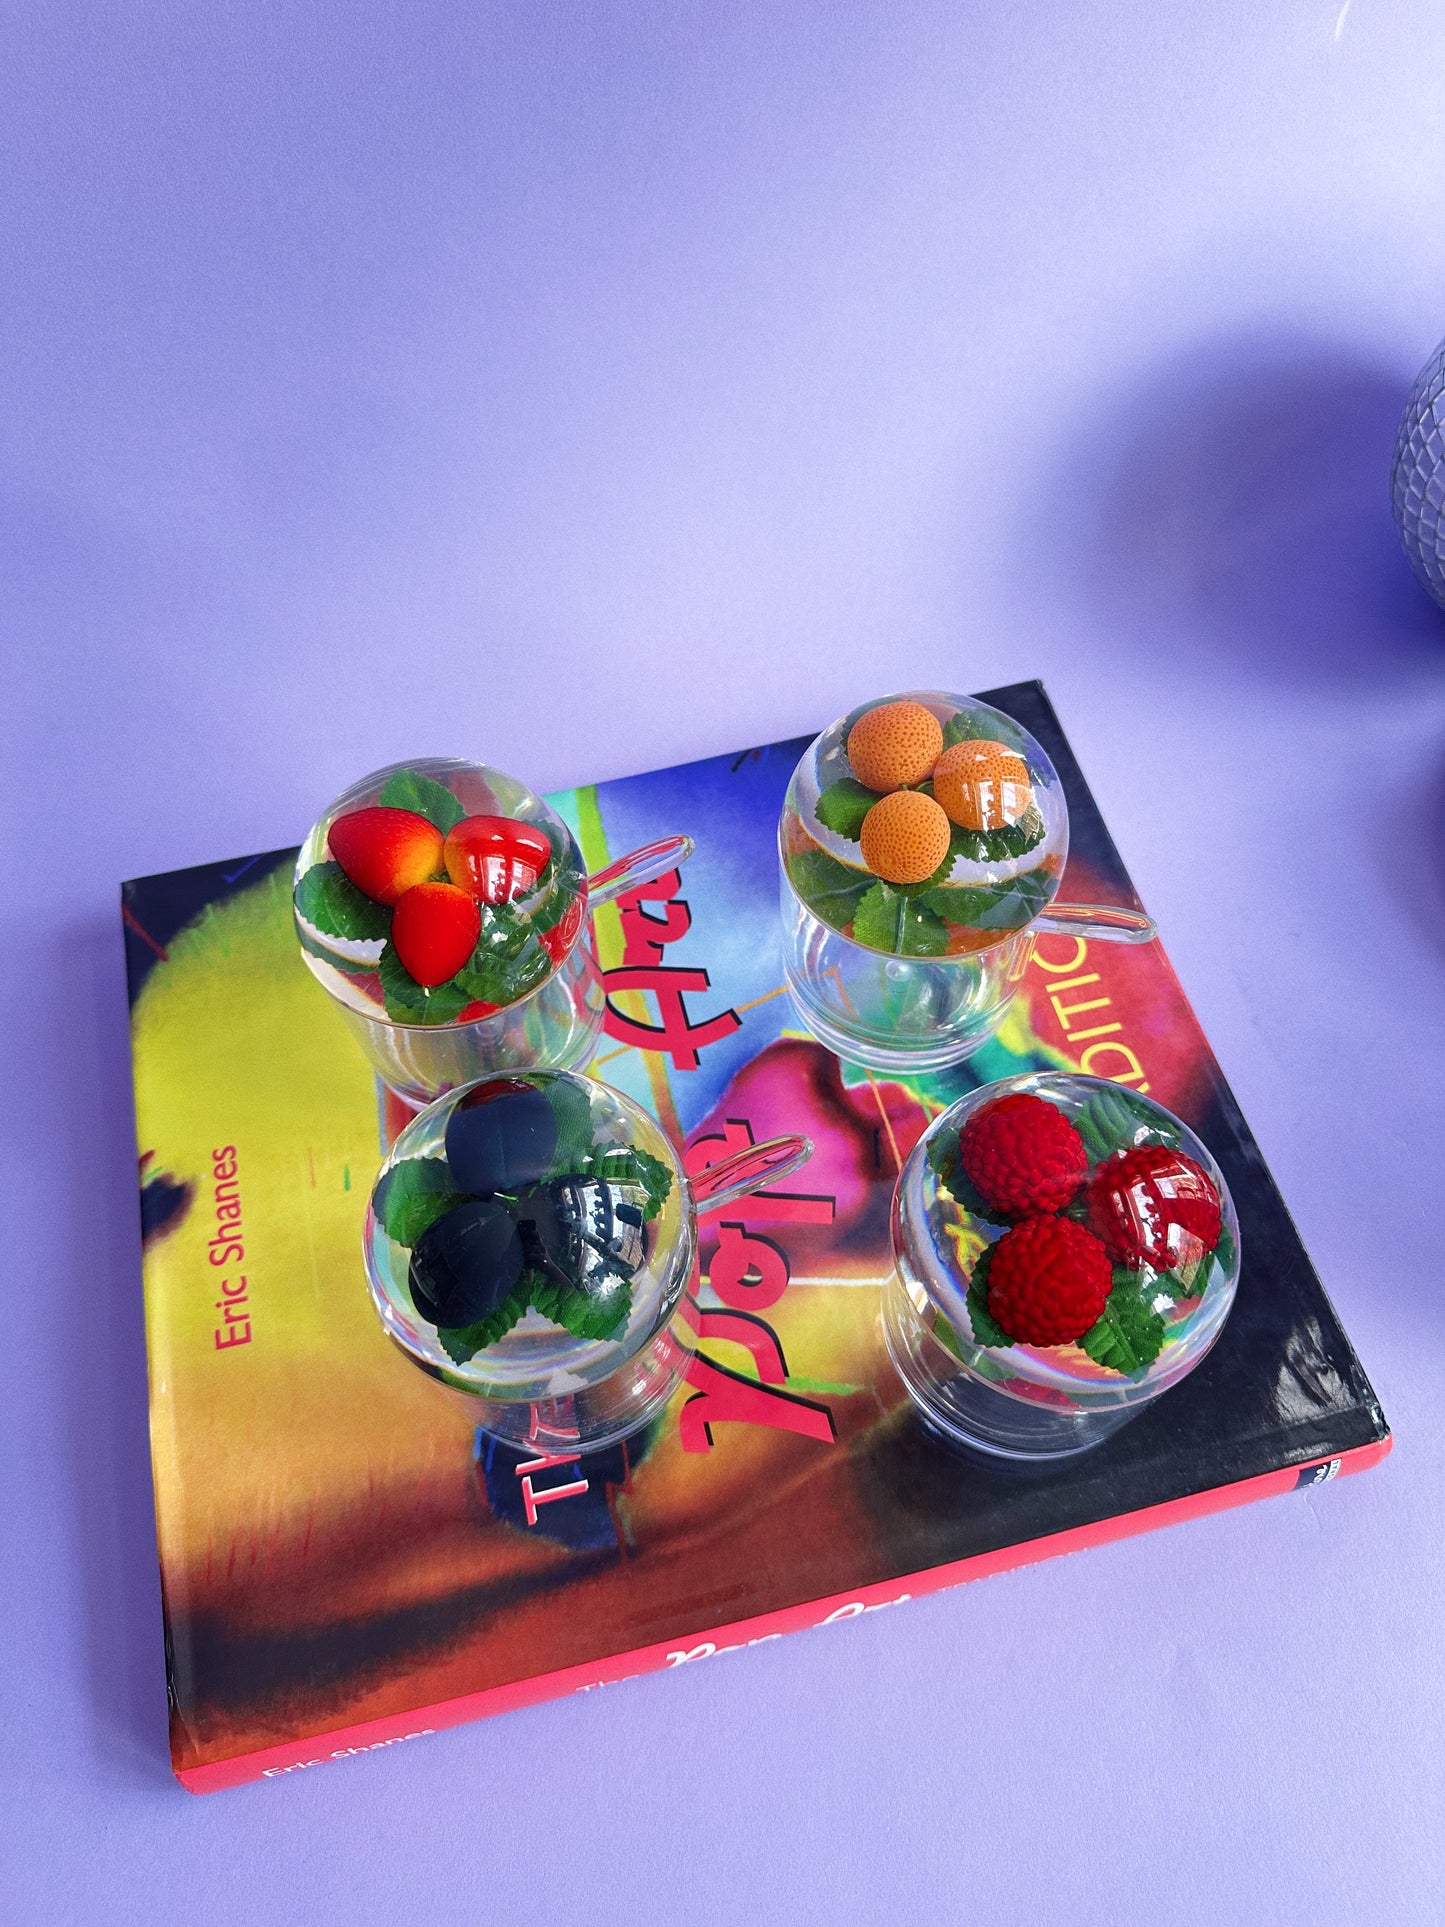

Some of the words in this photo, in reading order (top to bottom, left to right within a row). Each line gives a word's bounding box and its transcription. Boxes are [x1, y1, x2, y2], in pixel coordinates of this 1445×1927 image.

[208, 1144, 245, 1267] Shanes
[214, 1275, 252, 1350] Eric
[262, 1756, 325, 1778] Eric
[331, 1727, 436, 1760] Shanes
